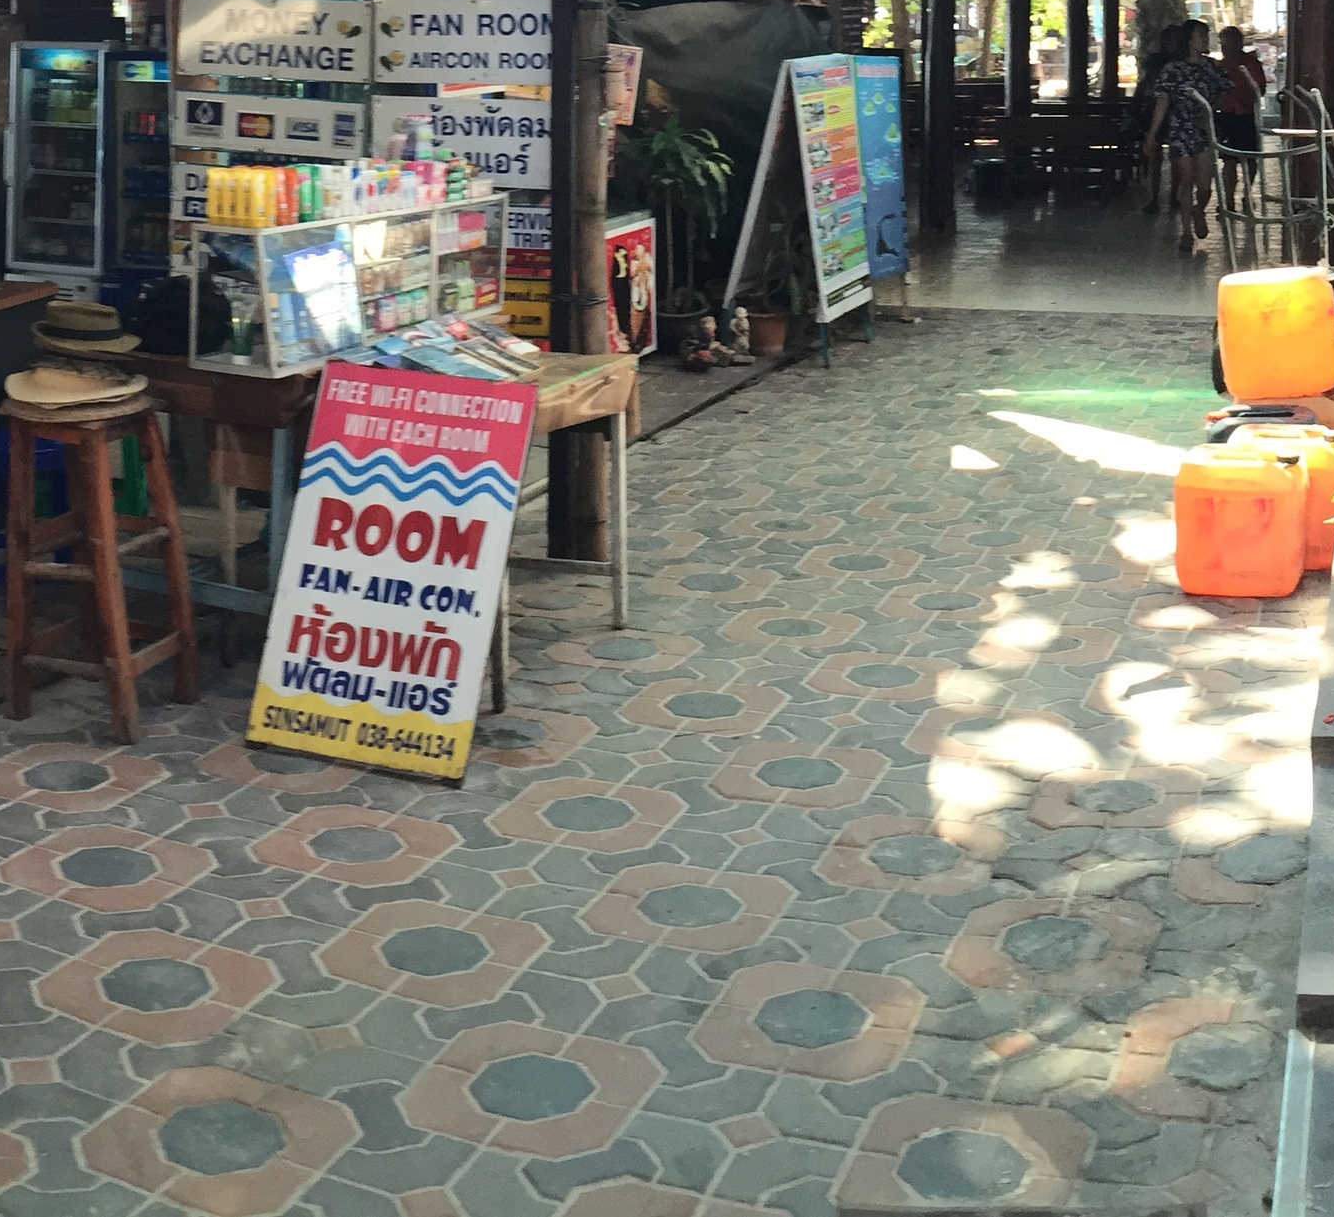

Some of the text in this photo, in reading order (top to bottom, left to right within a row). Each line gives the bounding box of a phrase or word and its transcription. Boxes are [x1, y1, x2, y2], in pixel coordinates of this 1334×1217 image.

[225, 9, 329, 36] MONEY
[409, 13, 463, 36] FAN
[198, 41, 355, 72] EXCHANGE
[407, 52, 552, 71] AIRCON ROO
[327, 378, 525, 424] FREE WI-FI CONNECTION
[344, 413, 491, 453] WITH EACH ROOM
[313, 496, 487, 571] ROOM
[299, 563, 481, 617] FAN-AIR CON.
[287, 603, 461, 681] ห้องพัก
[262, 705, 456, 761] SINSAMUT 038-644134
